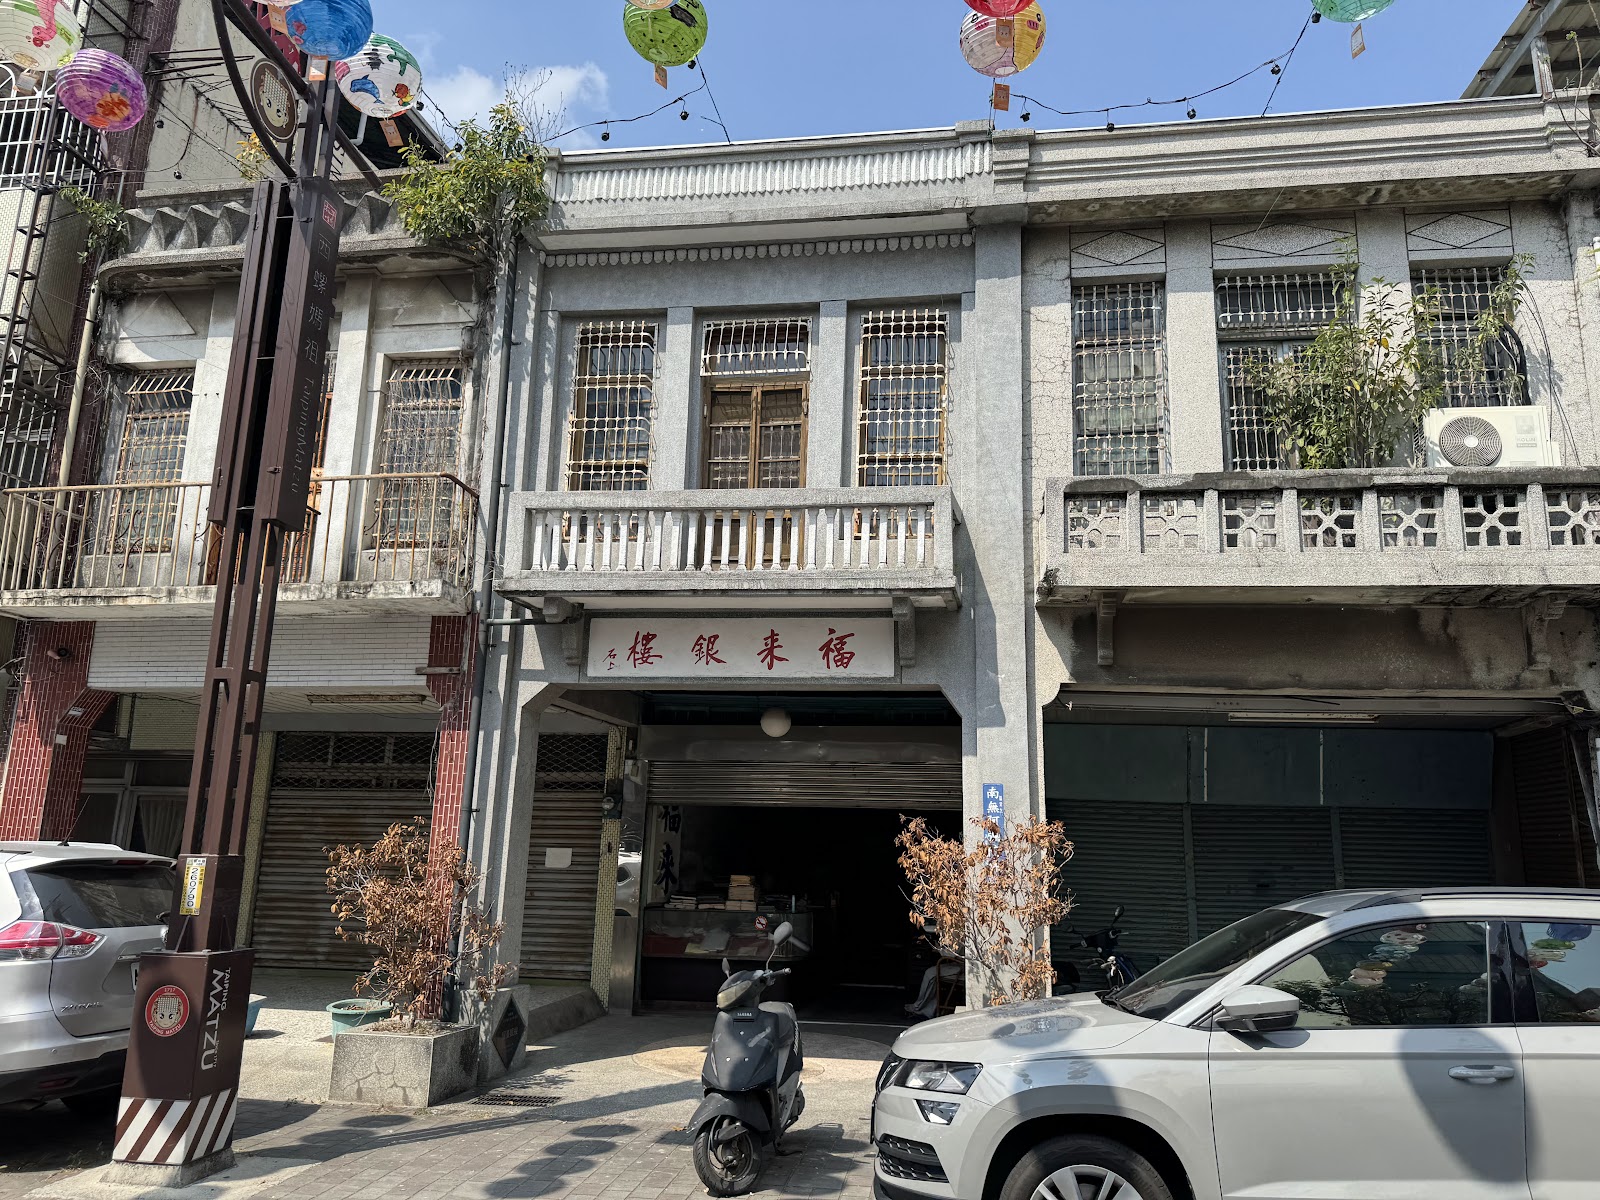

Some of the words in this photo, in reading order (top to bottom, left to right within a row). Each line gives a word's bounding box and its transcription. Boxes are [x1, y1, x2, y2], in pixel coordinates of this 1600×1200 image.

[304, 232, 332, 365] 西螺媽祖
[186, 867, 199, 908] 260790
[220, 967, 231, 1011] TAIPING
[149, 1020, 164, 1035] TAIPING
[165, 1023, 181, 1035] MATZU
[201, 968, 223, 1071] MATZU
